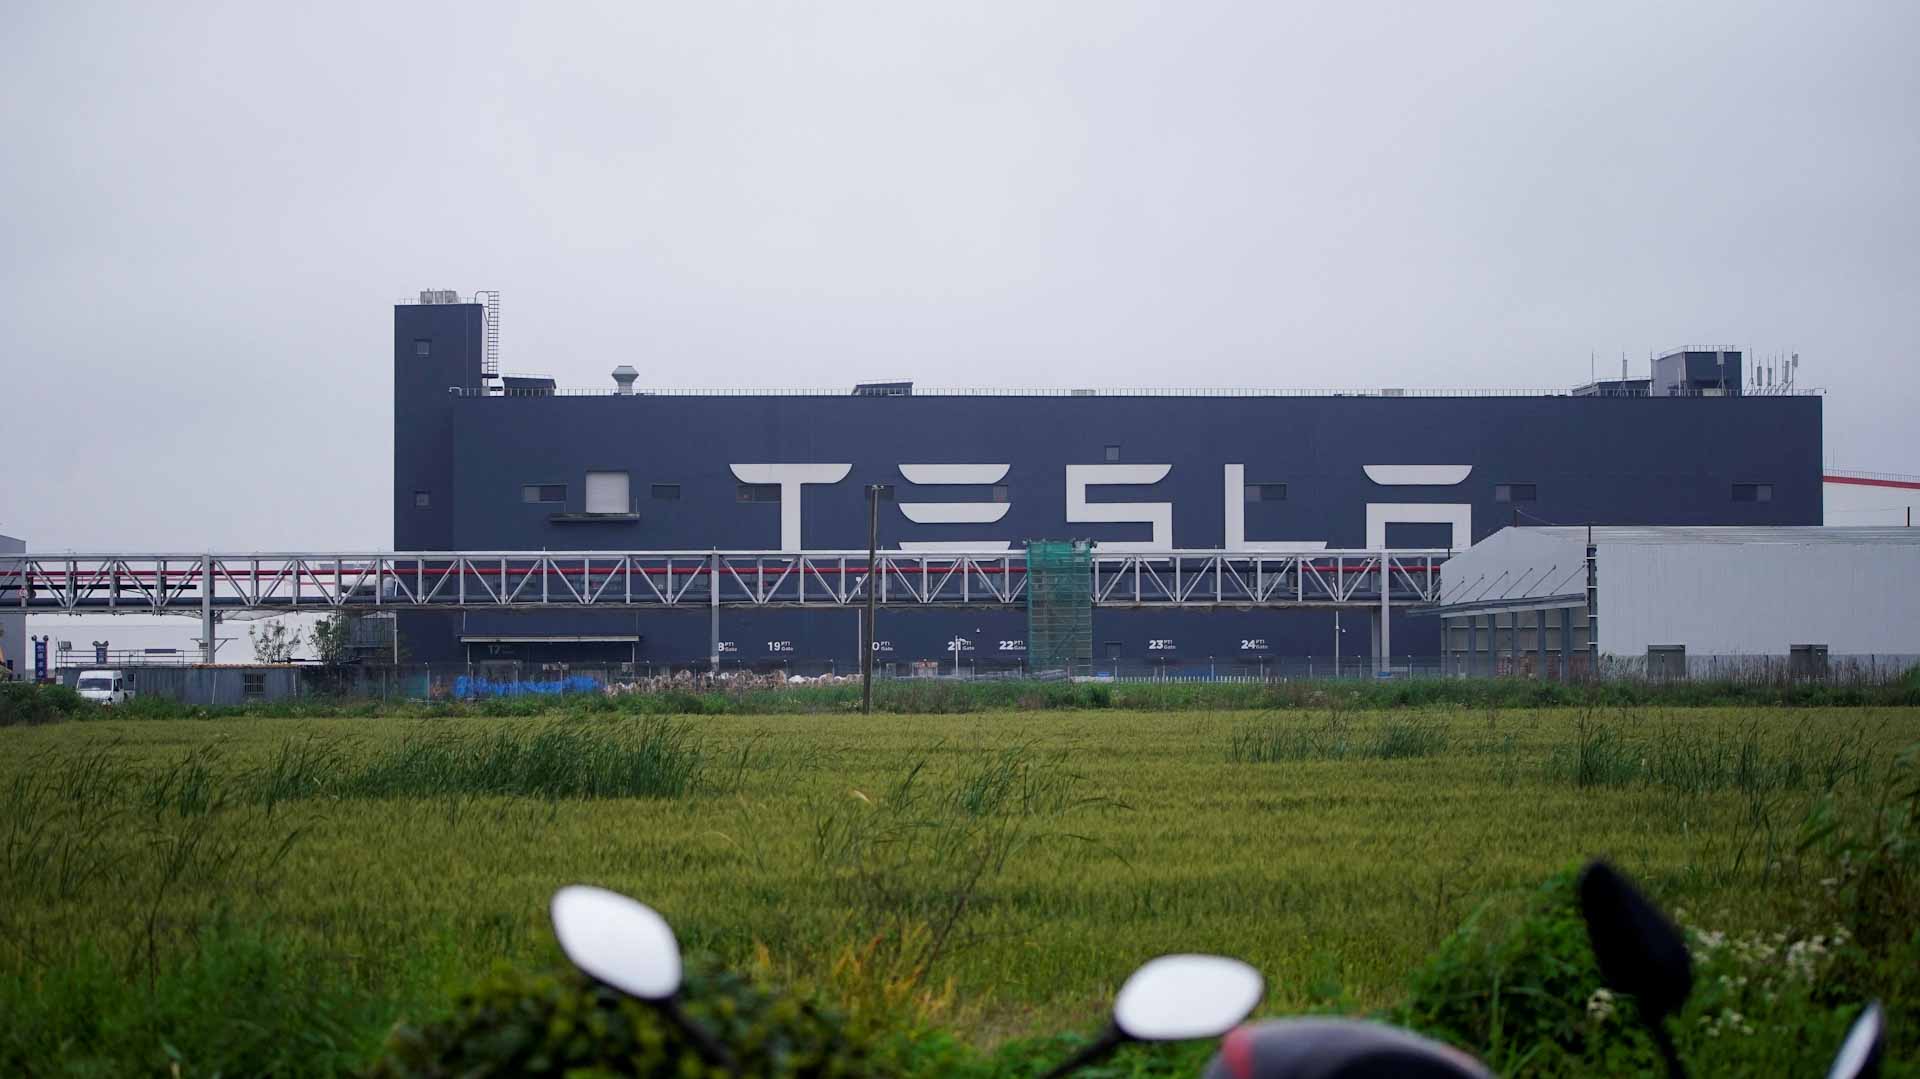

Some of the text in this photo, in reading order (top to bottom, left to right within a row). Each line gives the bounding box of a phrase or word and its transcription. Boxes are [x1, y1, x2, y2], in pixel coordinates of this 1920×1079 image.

[730, 463, 1472, 561] TESLA
[768, 641, 780, 651] 19
[947, 641, 961, 651] 21
[999, 641, 1013, 650] 22
[1149, 640, 1163, 649] 23
[1241, 640, 1255, 649] 24
